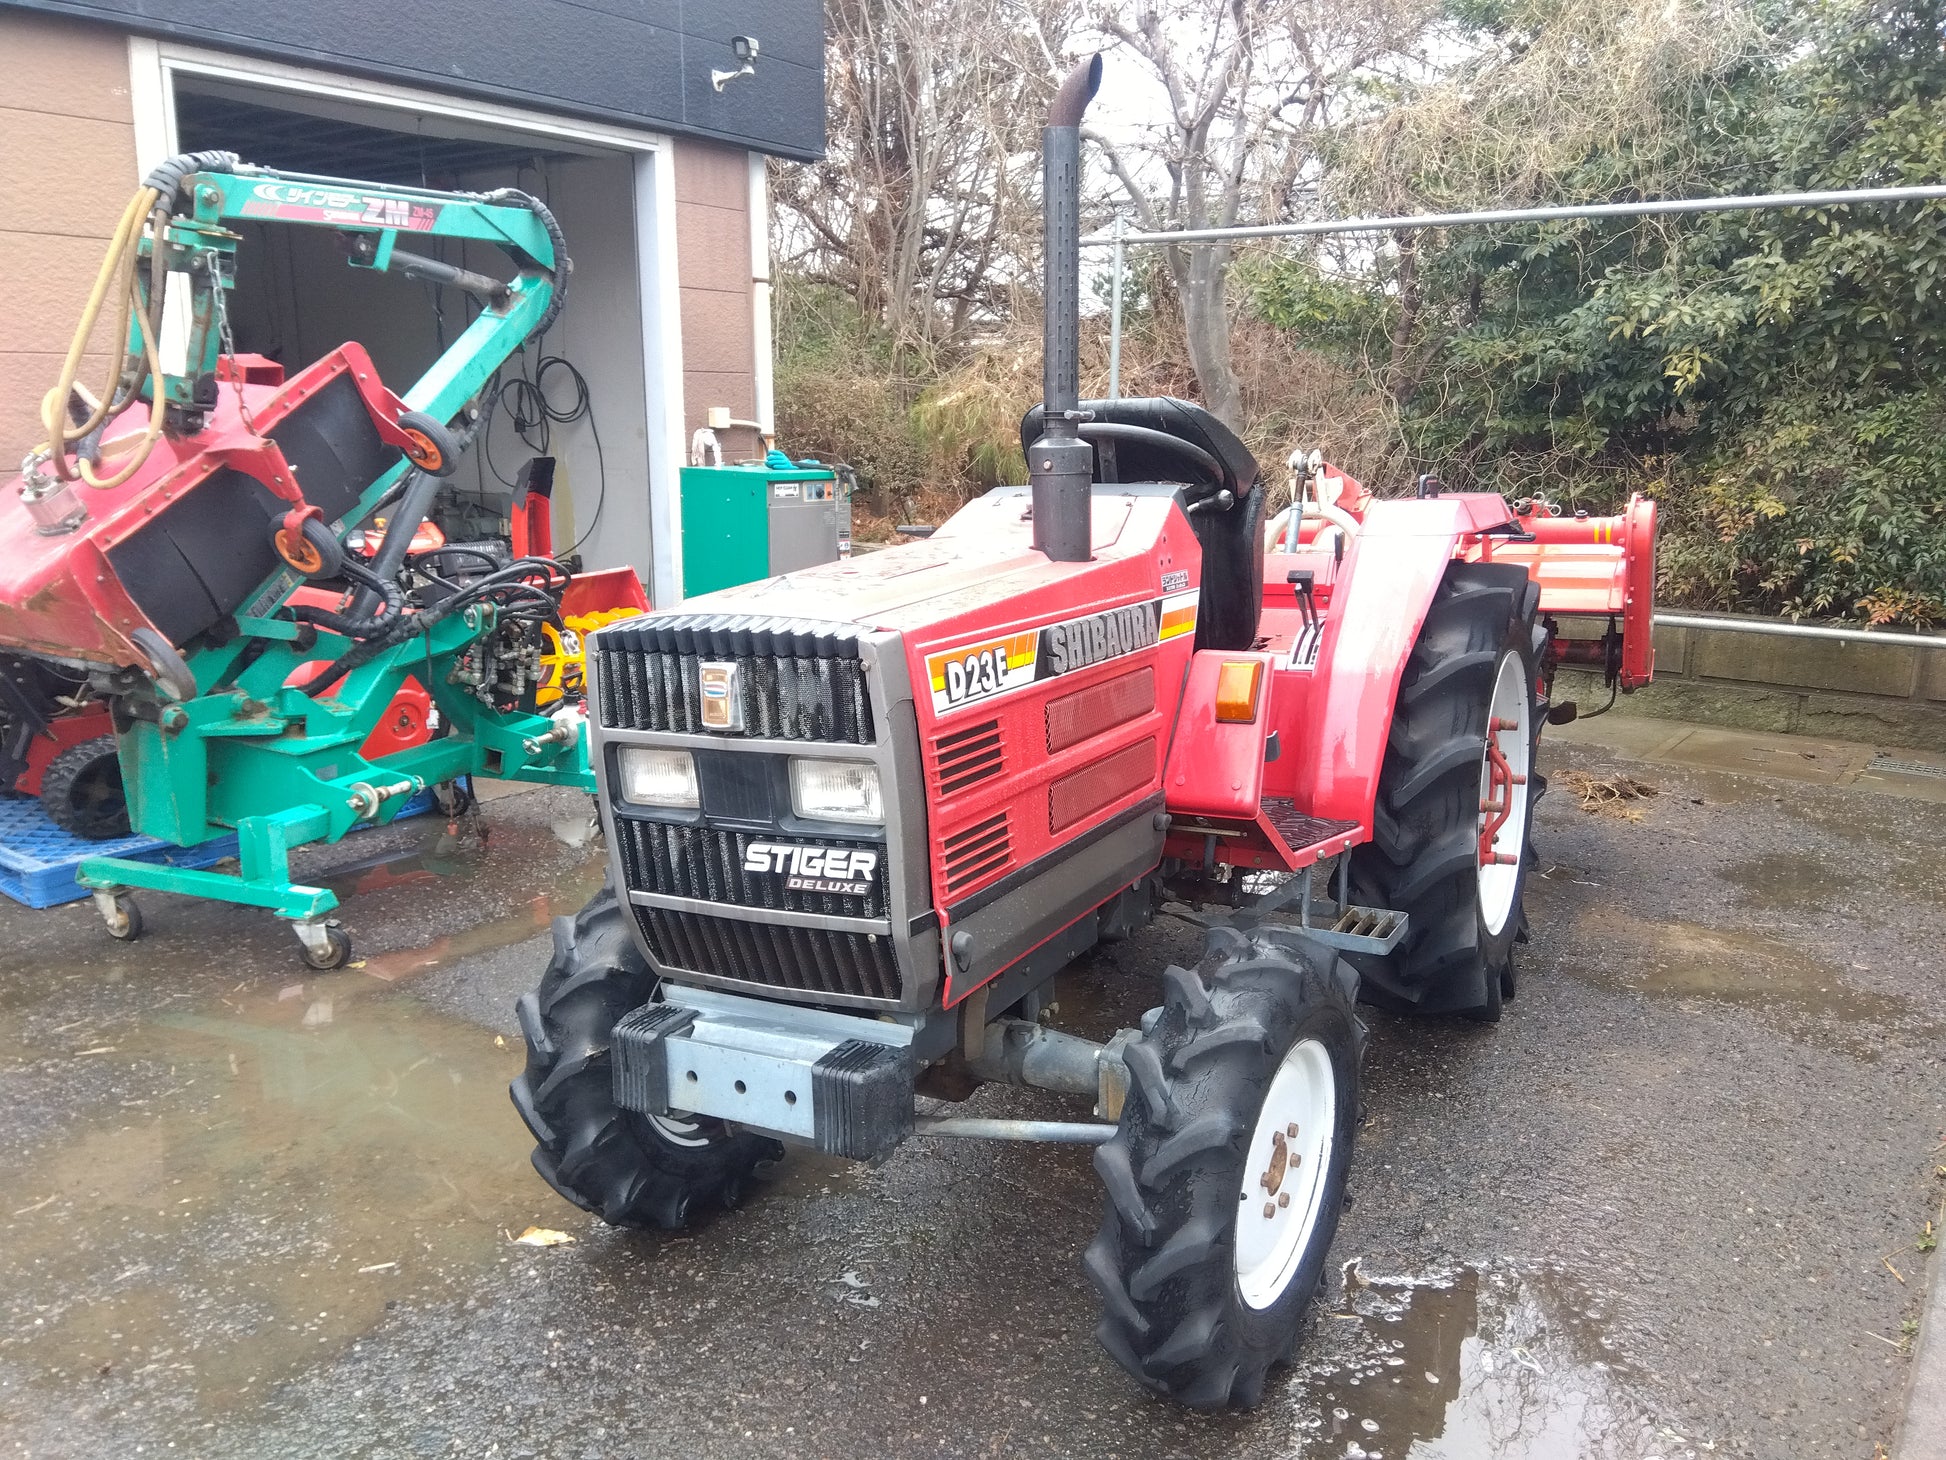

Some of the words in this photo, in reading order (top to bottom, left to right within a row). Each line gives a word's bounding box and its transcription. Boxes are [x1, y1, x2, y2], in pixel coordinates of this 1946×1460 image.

[361, 196, 409, 227] ZM
[1046, 602, 1159, 675] SHIBAURA
[744, 843, 878, 881] STIGER
[788, 878, 868, 894] DELUXE
